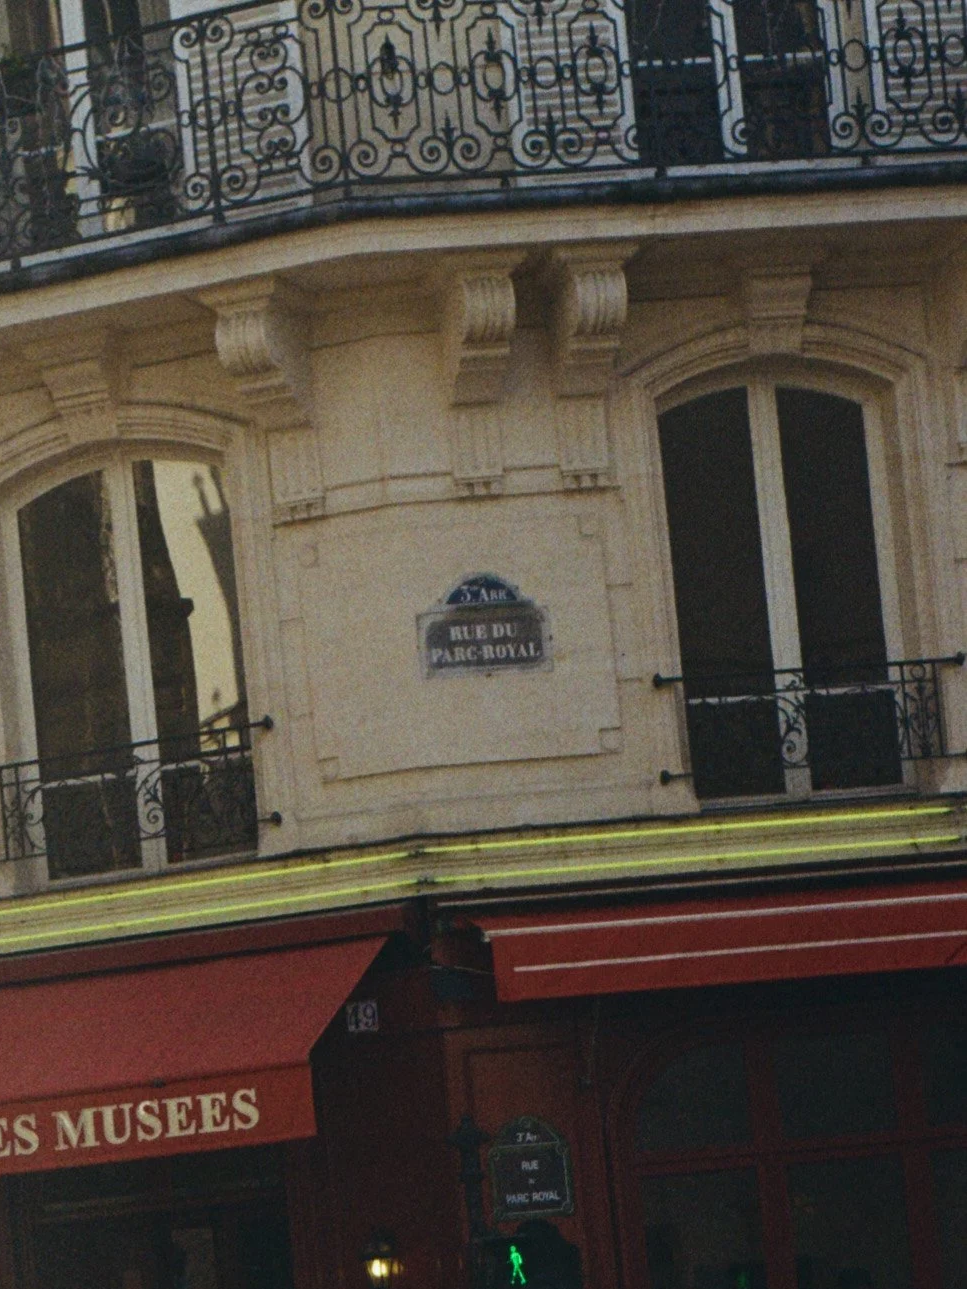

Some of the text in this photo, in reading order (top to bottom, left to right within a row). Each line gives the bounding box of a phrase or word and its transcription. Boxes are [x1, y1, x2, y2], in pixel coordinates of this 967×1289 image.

[449, 623, 516, 641] RUE DU
[432, 642, 540, 663] PARC-ROYAL
[52, 1087, 260, 1152] MUSEES
[521, 1160, 538, 1170] RUE
[506, 1190, 560, 1204] PARC ROYAL
